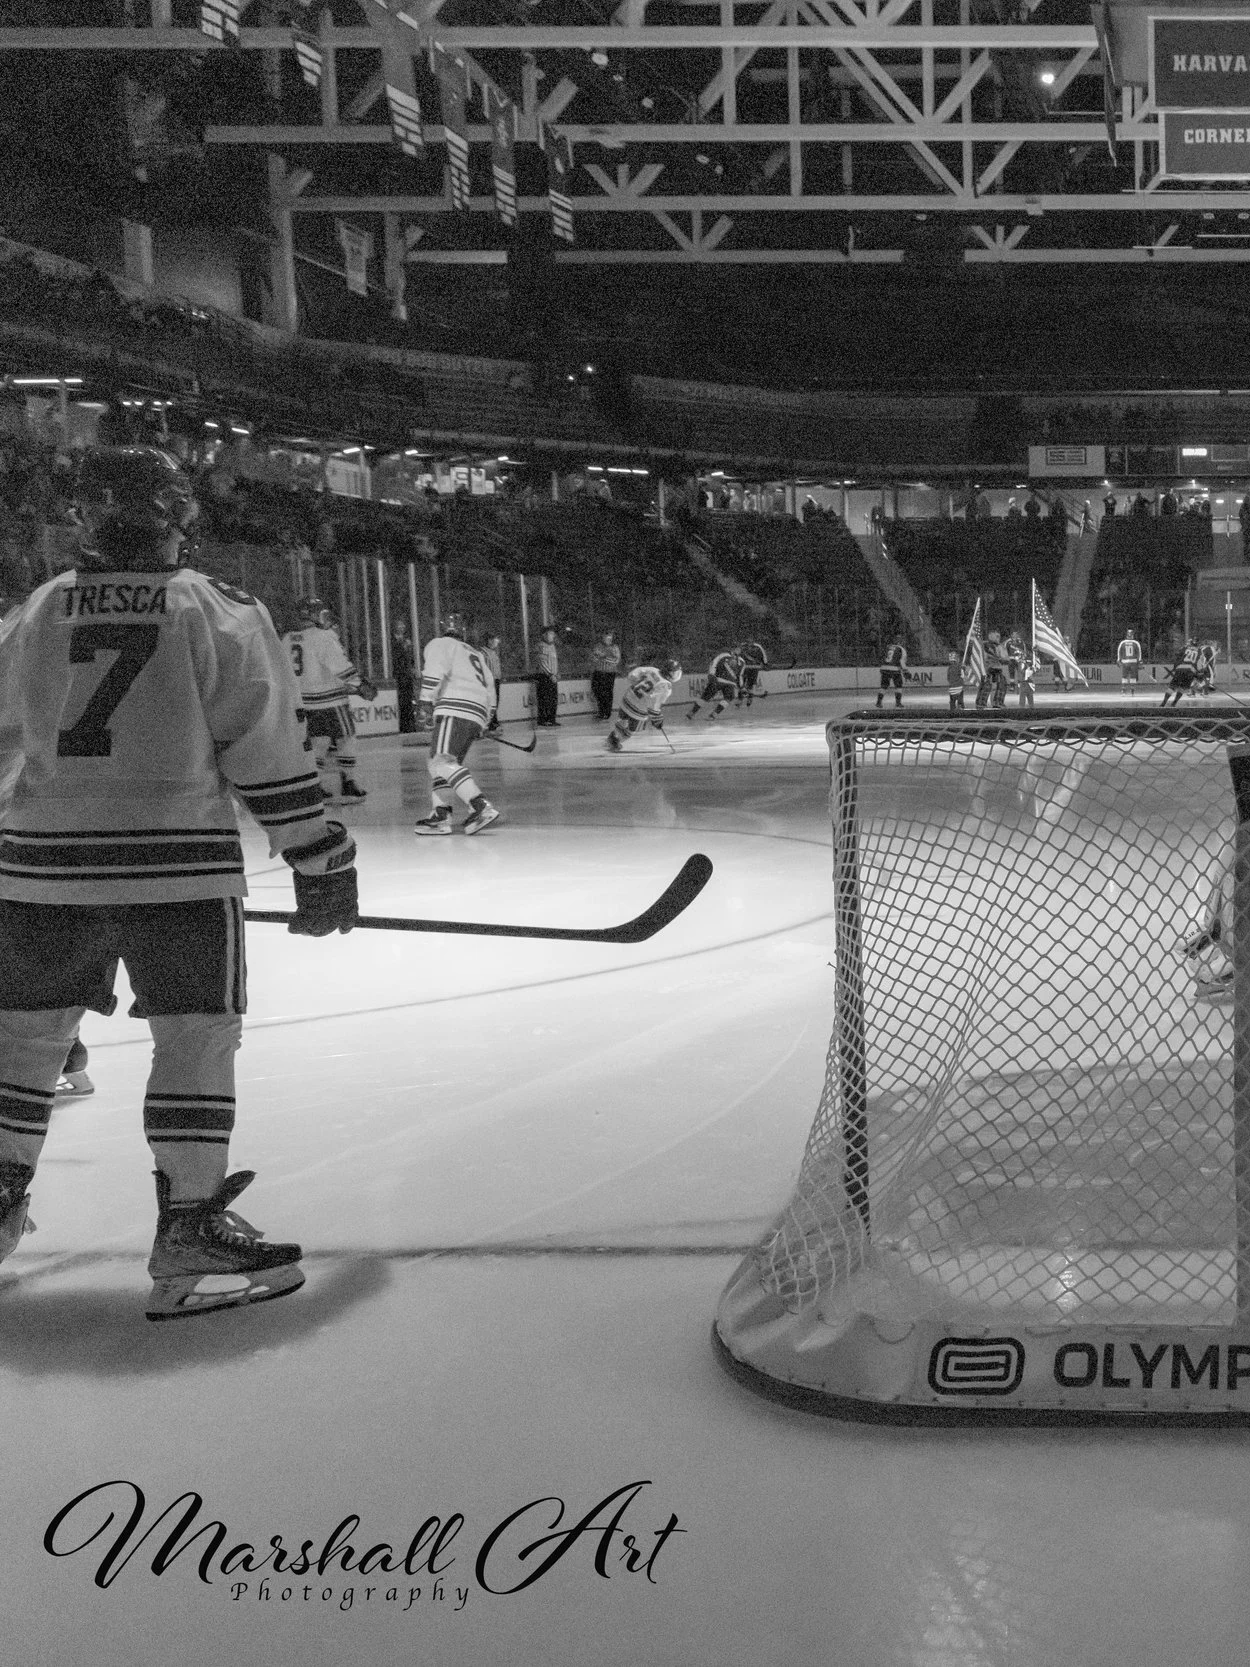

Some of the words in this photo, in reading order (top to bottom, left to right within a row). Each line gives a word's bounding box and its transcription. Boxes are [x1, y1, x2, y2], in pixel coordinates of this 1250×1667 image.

[63, 583, 167, 618] TRESCA
[1125, 645, 1134, 657] 10
[1183, 648, 1198, 662] 20
[787, 671, 816, 689] COLGATE
[56, 623, 160, 758] 7
